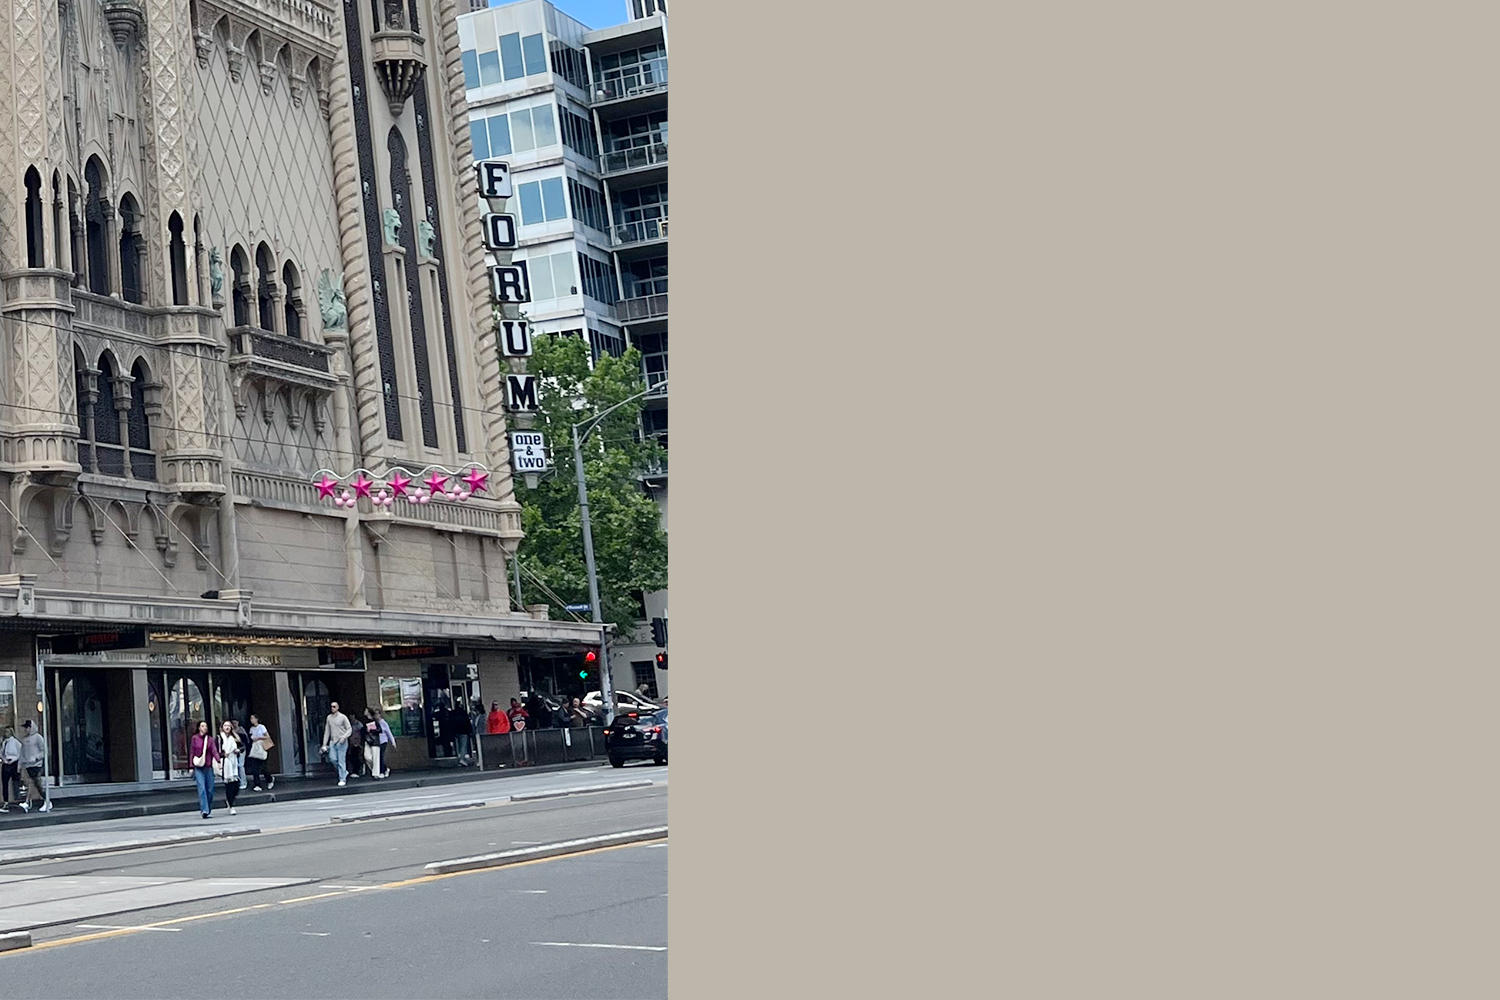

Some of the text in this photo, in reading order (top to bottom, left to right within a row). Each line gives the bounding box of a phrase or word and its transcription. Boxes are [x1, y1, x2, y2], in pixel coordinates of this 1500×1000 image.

[484, 162, 538, 410] FORUM
[515, 434, 541, 445] one
[526, 445, 534, 456] &
[518, 455, 544, 468] two
[85, 633, 119, 645] FORUM
